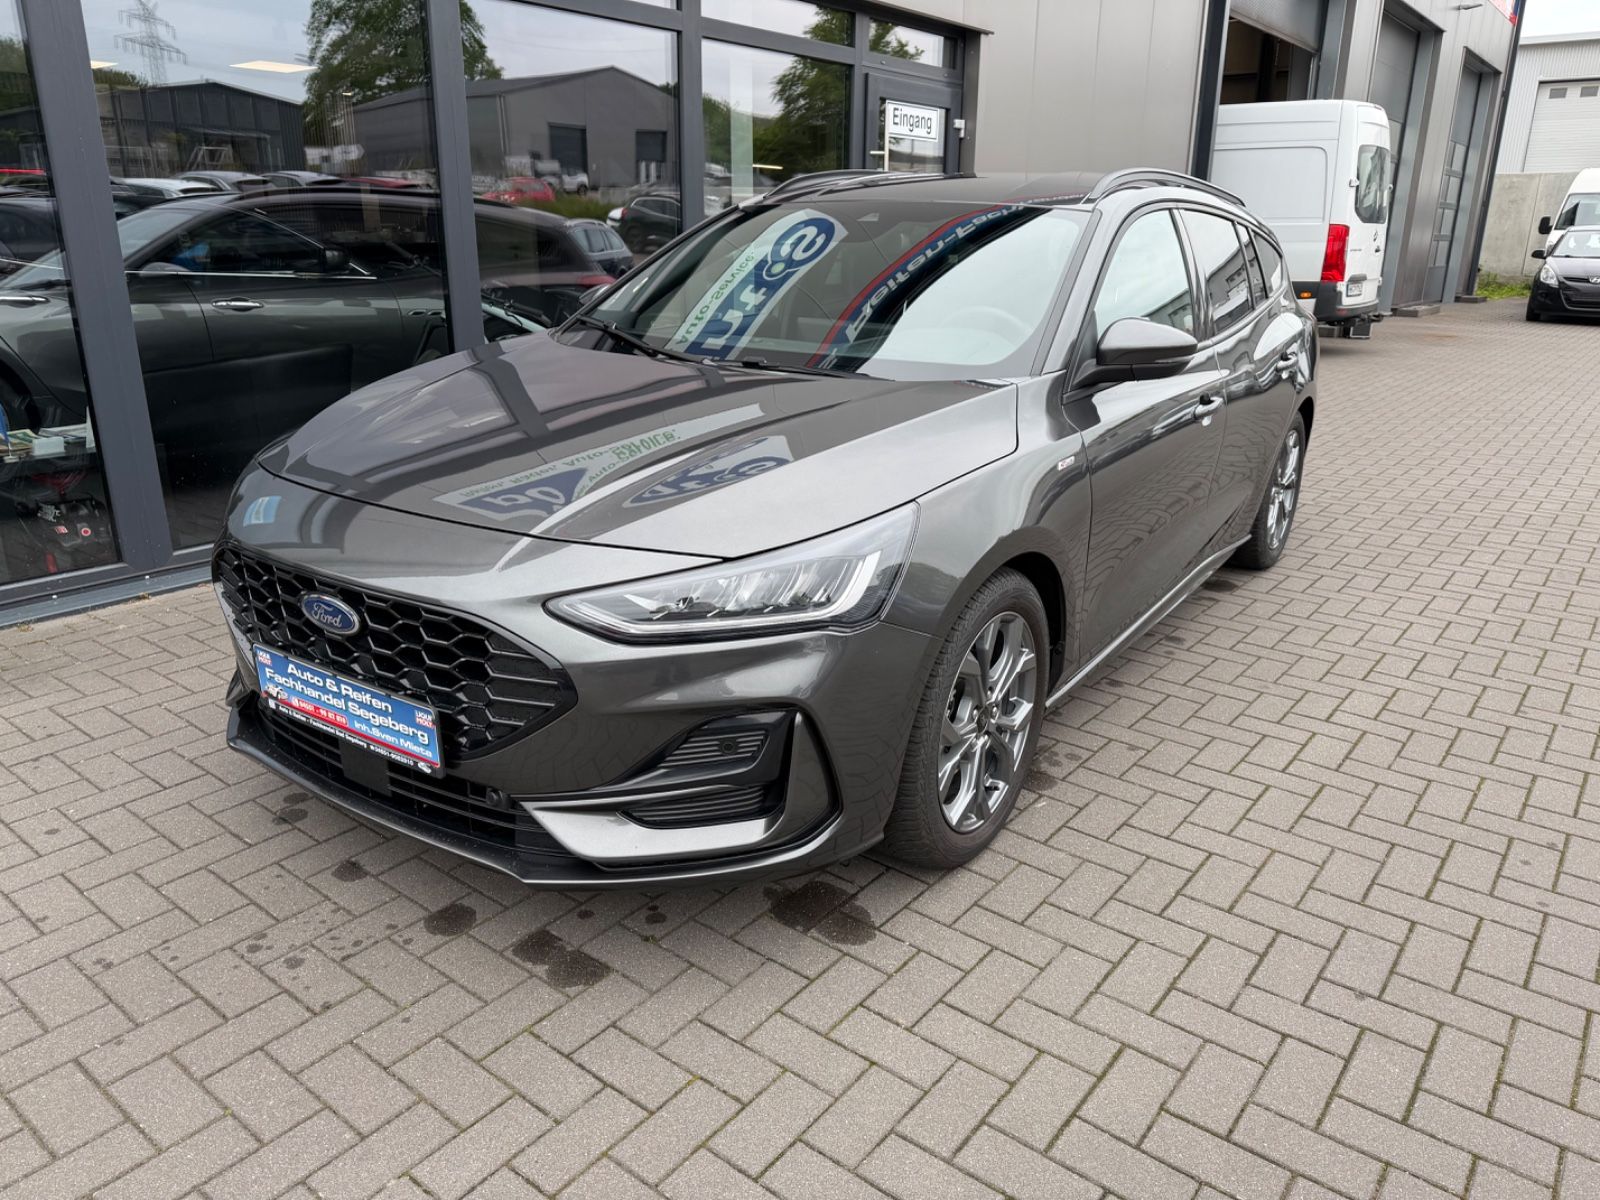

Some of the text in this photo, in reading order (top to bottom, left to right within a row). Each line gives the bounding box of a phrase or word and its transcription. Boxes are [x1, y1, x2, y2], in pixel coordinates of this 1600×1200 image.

[892, 107, 932, 135] Eingang
[311, 602, 342, 627] Ford
[265, 667, 429, 745] Fachhandel Segeberg
[287, 663, 392, 713] Auto & Reifen
